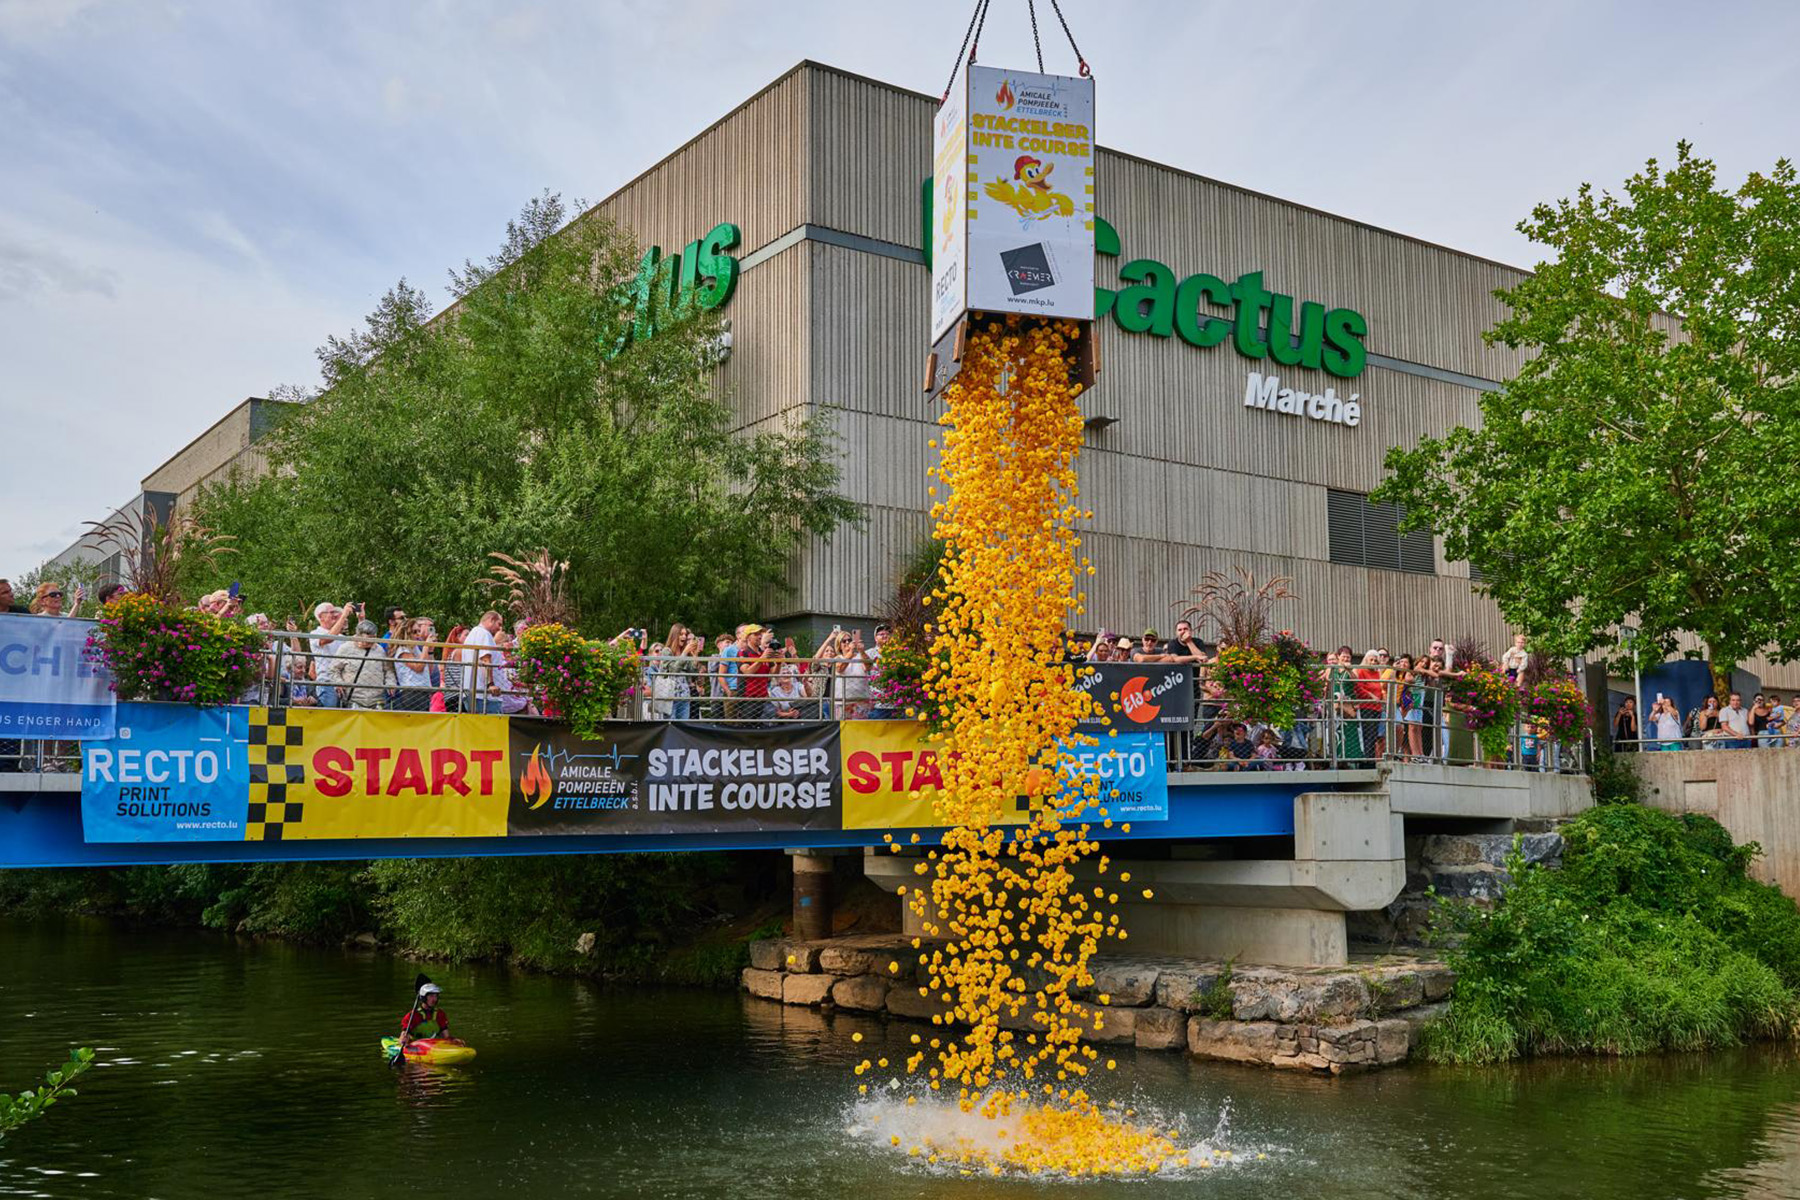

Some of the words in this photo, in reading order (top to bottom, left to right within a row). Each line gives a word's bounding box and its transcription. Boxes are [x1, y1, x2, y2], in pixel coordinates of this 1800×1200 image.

[1020, 90, 1052, 101] AMICALE
[972, 113, 1090, 140] STACKELSER
[972, 130, 1014, 150] INTE
[1018, 136, 1091, 158] COURSE
[1007, 296, 1055, 308] www.mkp.lu
[1244, 372, 1362, 427] Marché
[17, 715, 61, 726] ENGER
[88, 748, 219, 784] RECTO
[648, 747, 831, 778] STACKELSER
[312, 746, 504, 797] START
[560, 765, 612, 779] AMICALE
[118, 786, 171, 801] PRINT
[557, 779, 626, 794] POMPJEEËN
[553, 794, 630, 810] ETTELBRÉCK
[649, 783, 714, 812] INTE
[720, 781, 832, 811] COURSE
[116, 802, 212, 817] SOLUTIONS
[176, 820, 238, 830] www.recto.lu
